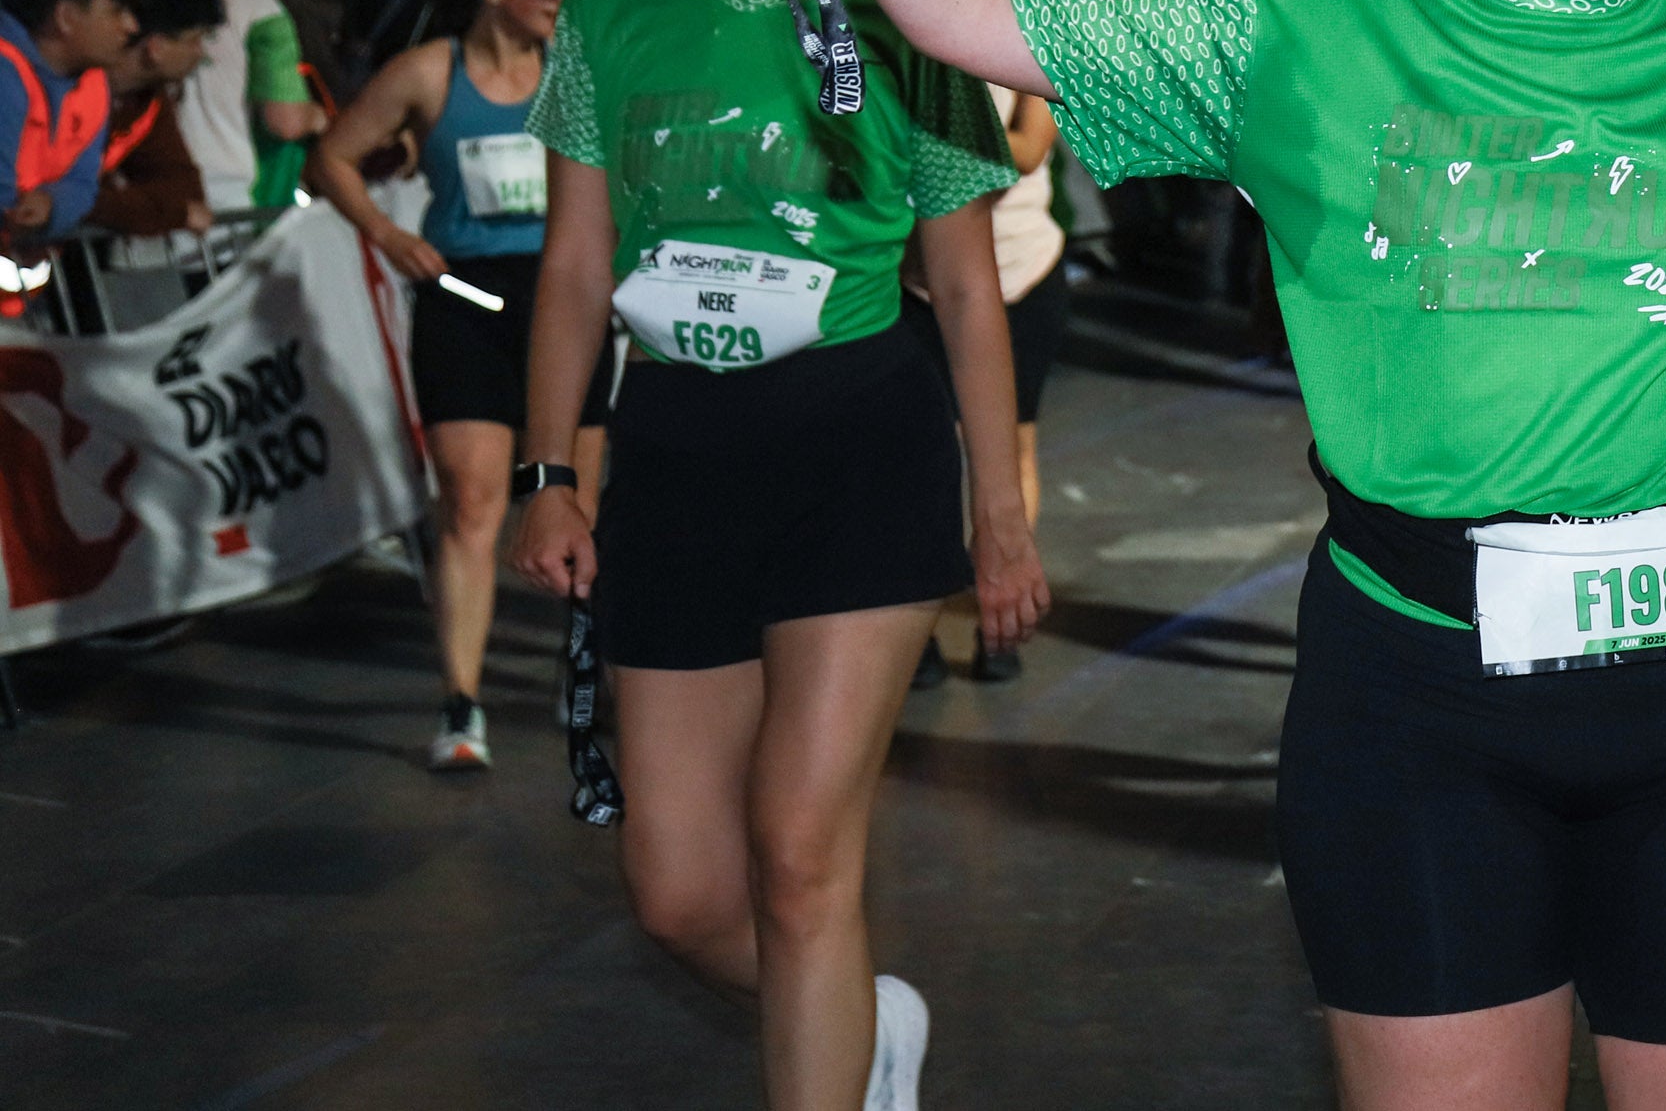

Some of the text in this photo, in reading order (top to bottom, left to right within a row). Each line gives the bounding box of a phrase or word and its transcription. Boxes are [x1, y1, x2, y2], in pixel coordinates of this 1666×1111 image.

[831, 40, 862, 115] NISHER
[1382, 105, 1544, 161] BINTER
[771, 200, 820, 228] 2025
[806, 274, 822, 291] 3
[1419, 256, 1588, 311] SERIES
[698, 290, 738, 314] NERE
[673, 320, 764, 363] F629
[1619, 637, 1640, 648] JUN
[1641, 634, 1666, 645] 2025
